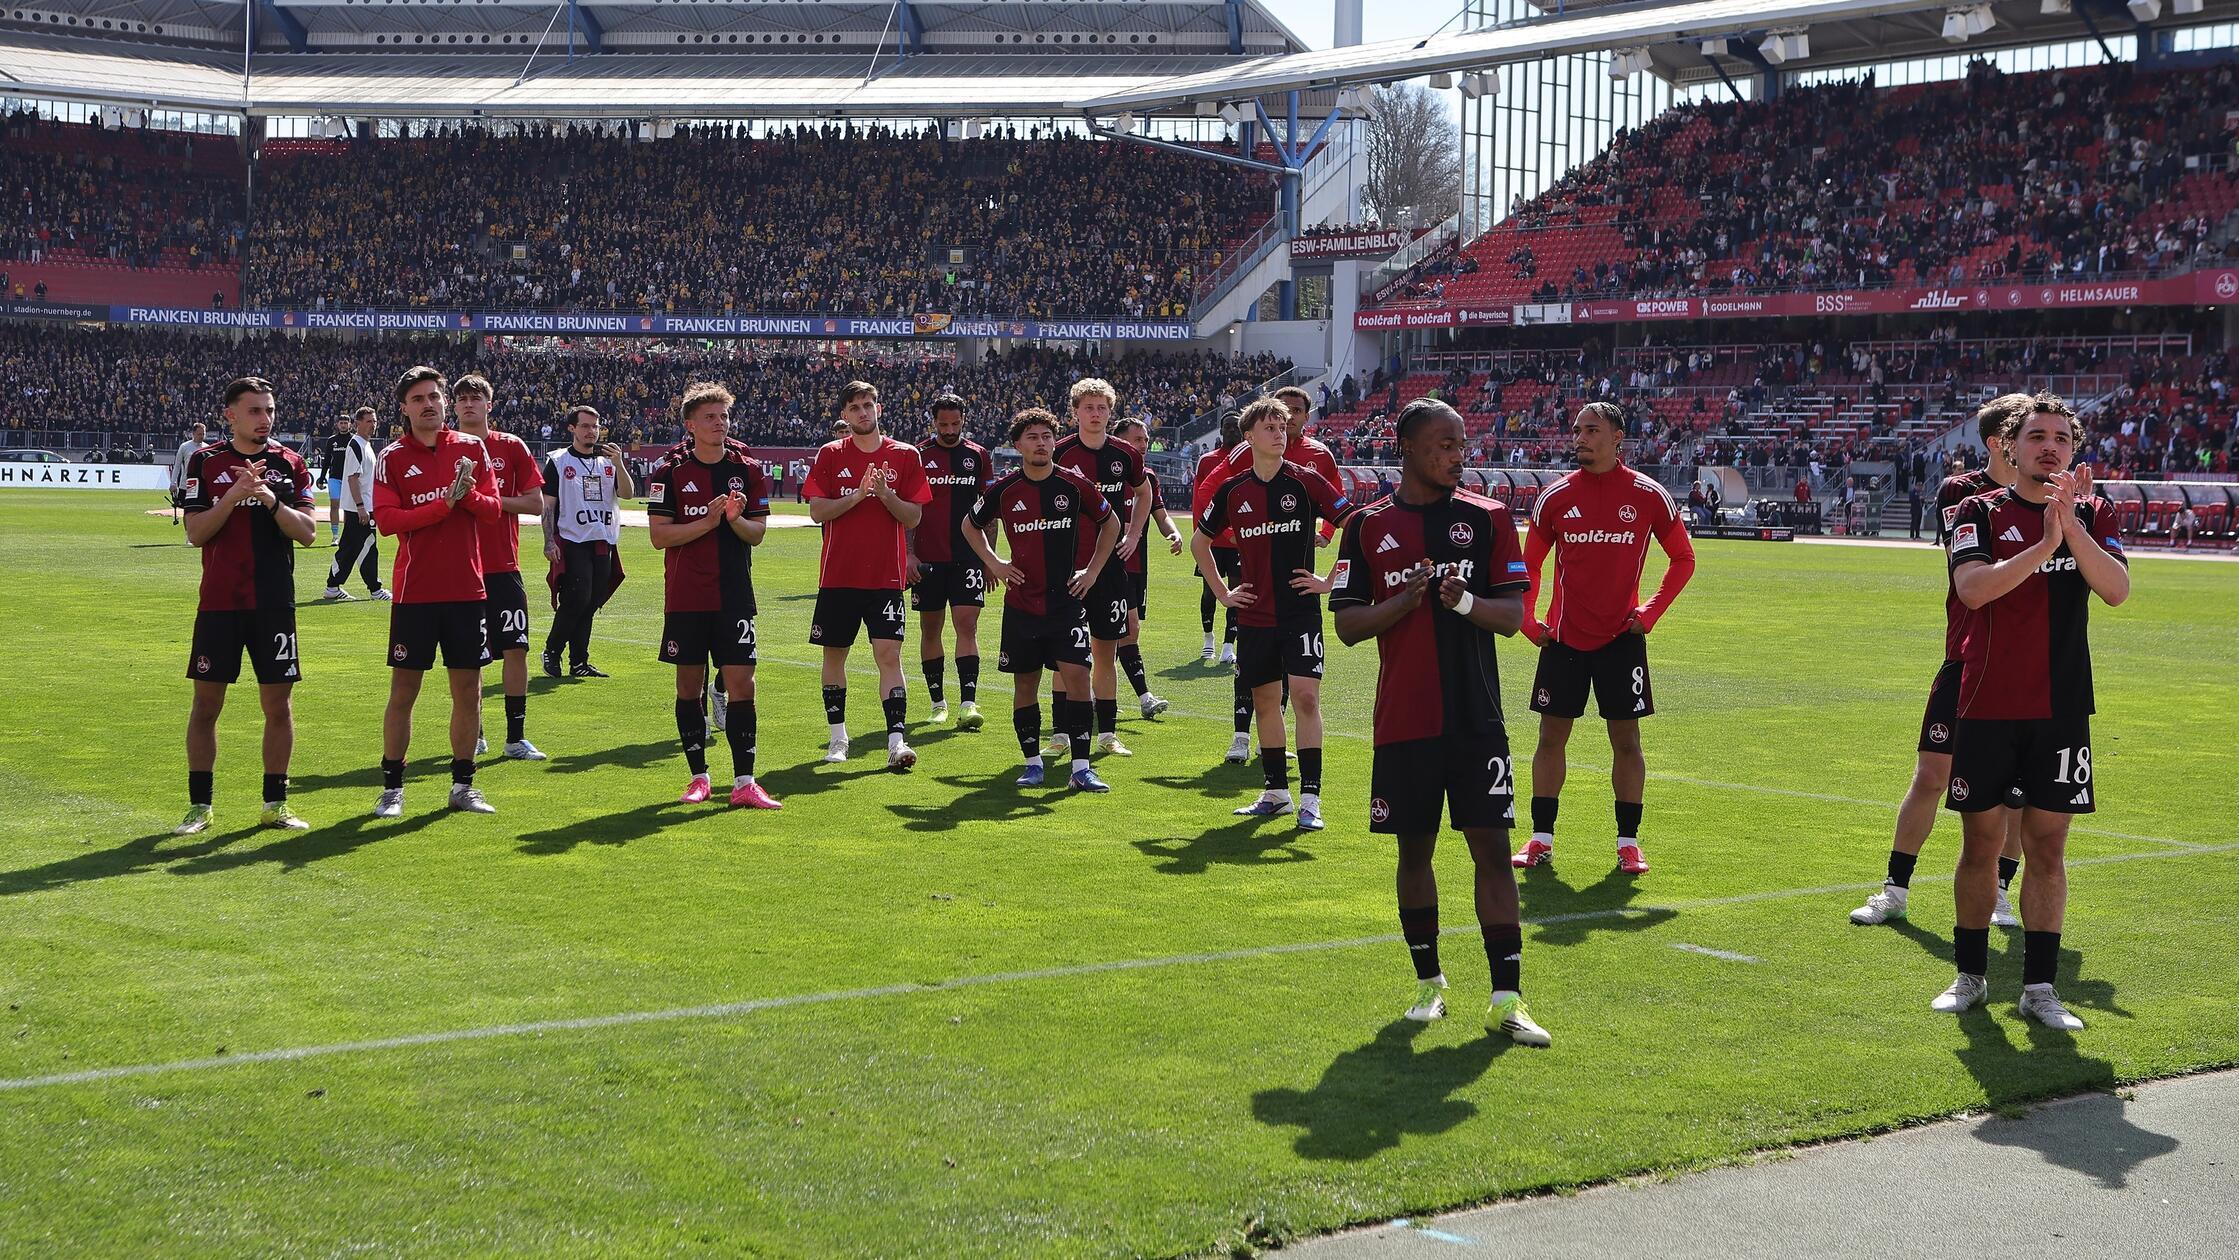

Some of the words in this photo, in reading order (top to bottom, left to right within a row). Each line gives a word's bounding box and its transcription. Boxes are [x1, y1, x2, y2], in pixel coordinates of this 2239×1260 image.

[1910, 290, 1968, 308] nibler
[2060, 287, 2138, 302] HELMSAUER
[14, 305, 92, 317] stadion-nuernberg.de
[1652, 301, 1688, 312] POWER
[1711, 302, 1762, 312] GODELMANN
[1816, 295, 1844, 312] BSS
[130, 308, 199, 324] FRANKEN
[203, 309, 270, 326] BRUNNEN
[308, 314, 375, 328] FRANKEN
[379, 314, 446, 328] BRUNNEN
[1468, 312, 1478, 320] die
[1478, 310, 1508, 320] Bayerische
[485, 316, 553, 330] FRANKEN
[557, 316, 626, 330] BRUNNEN
[666, 318, 735, 332] FRANKEN
[740, 319, 810, 333] BRUNNEN
[936, 321, 998, 336] UNNEN
[1038, 324, 1111, 338] FRANKEN
[1116, 324, 1190, 339] BRUNNEN
[1, 465, 121, 483] HNÄRZTE
[1621, 511, 1634, 520] FCN
[1452, 531, 1471, 540] FCN
[966, 568, 984, 589] 33
[882, 600, 905, 623] 44
[1110, 598, 1128, 623] 39
[500, 609, 526, 632] 20
[274, 632, 298, 660] 21
[1300, 632, 1323, 659] 16
[1632, 666, 1644, 695] 8
[1931, 730, 1946, 738] FCN
[2054, 746, 2091, 785] 18
[1952, 786, 1966, 796] FCN
[1371, 807, 1387, 817] FCN
